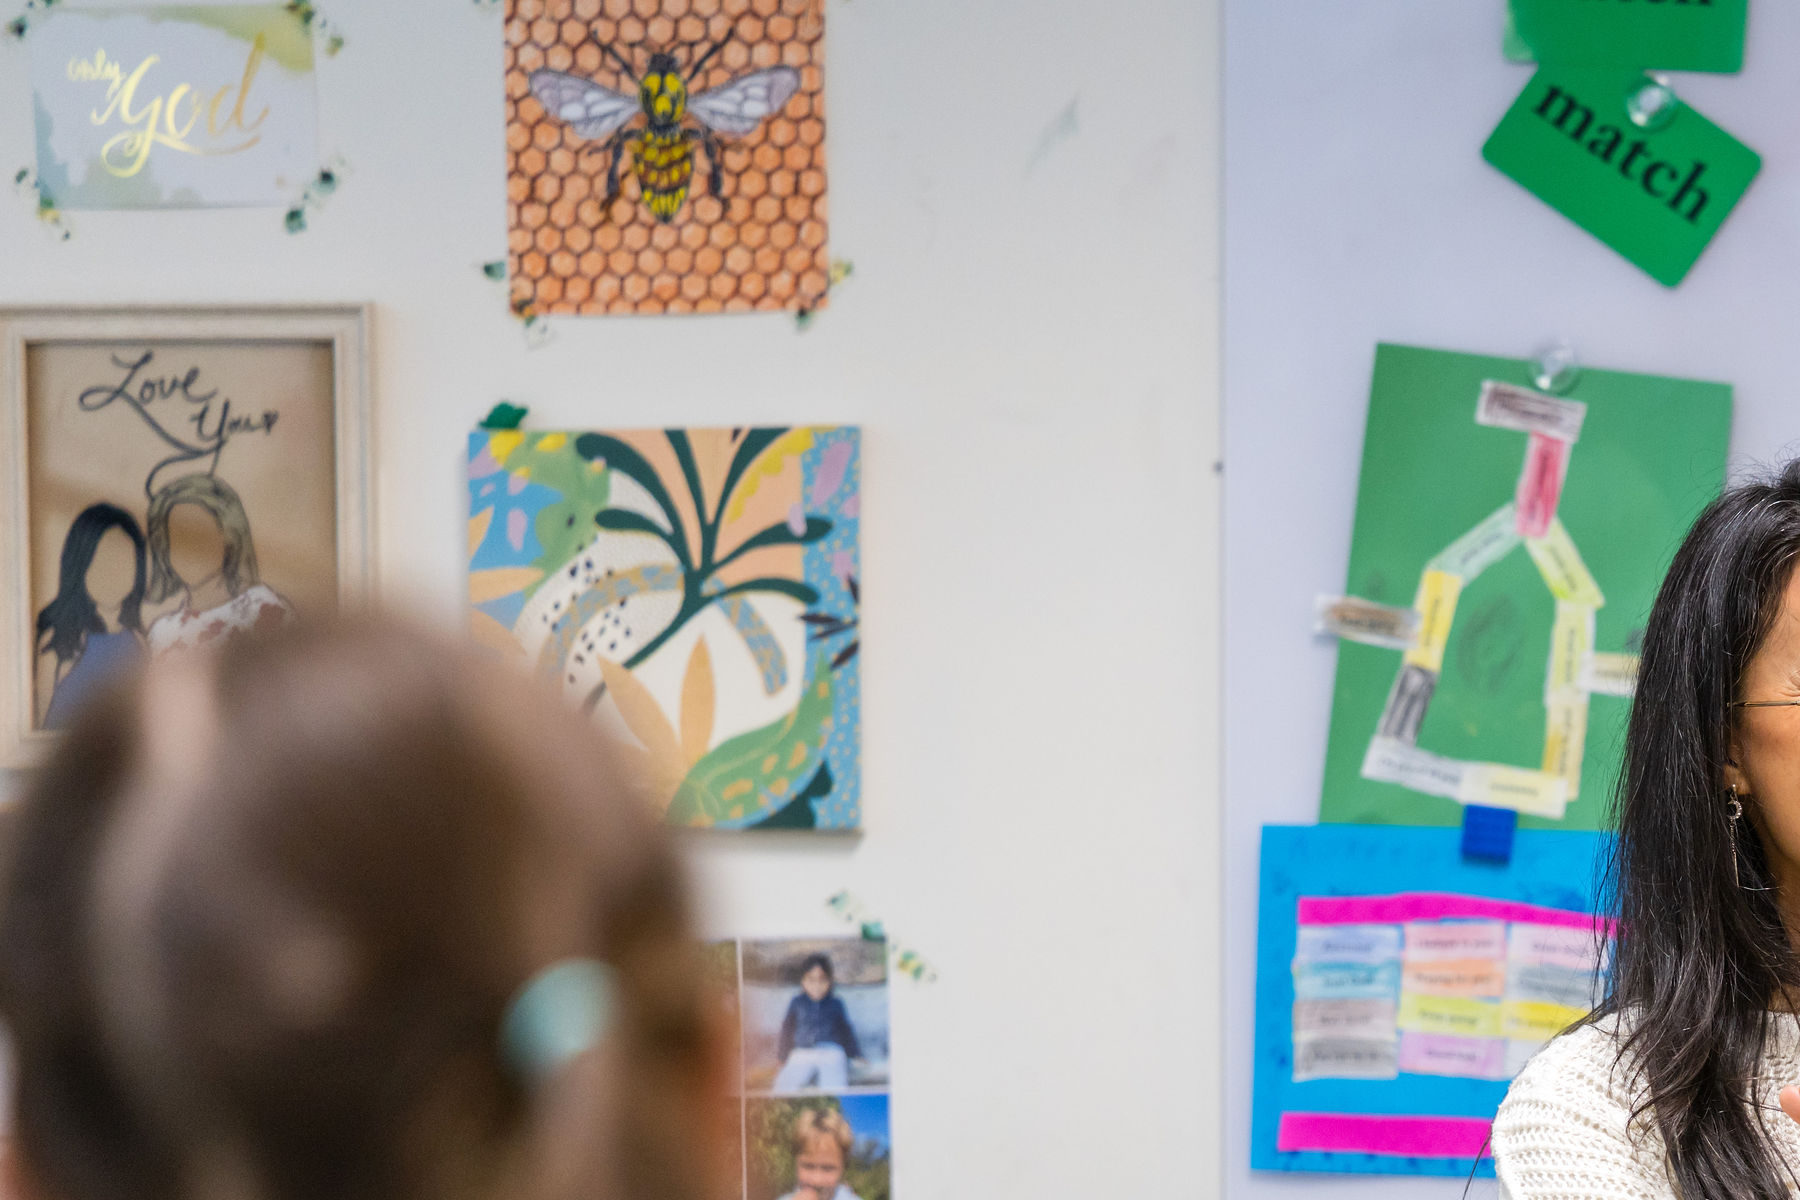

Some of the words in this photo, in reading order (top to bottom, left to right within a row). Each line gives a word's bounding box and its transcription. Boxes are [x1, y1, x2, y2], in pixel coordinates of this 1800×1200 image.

[90, 32, 269, 178] God
[1532, 84, 1709, 226] match
[79, 350, 219, 412] Love
